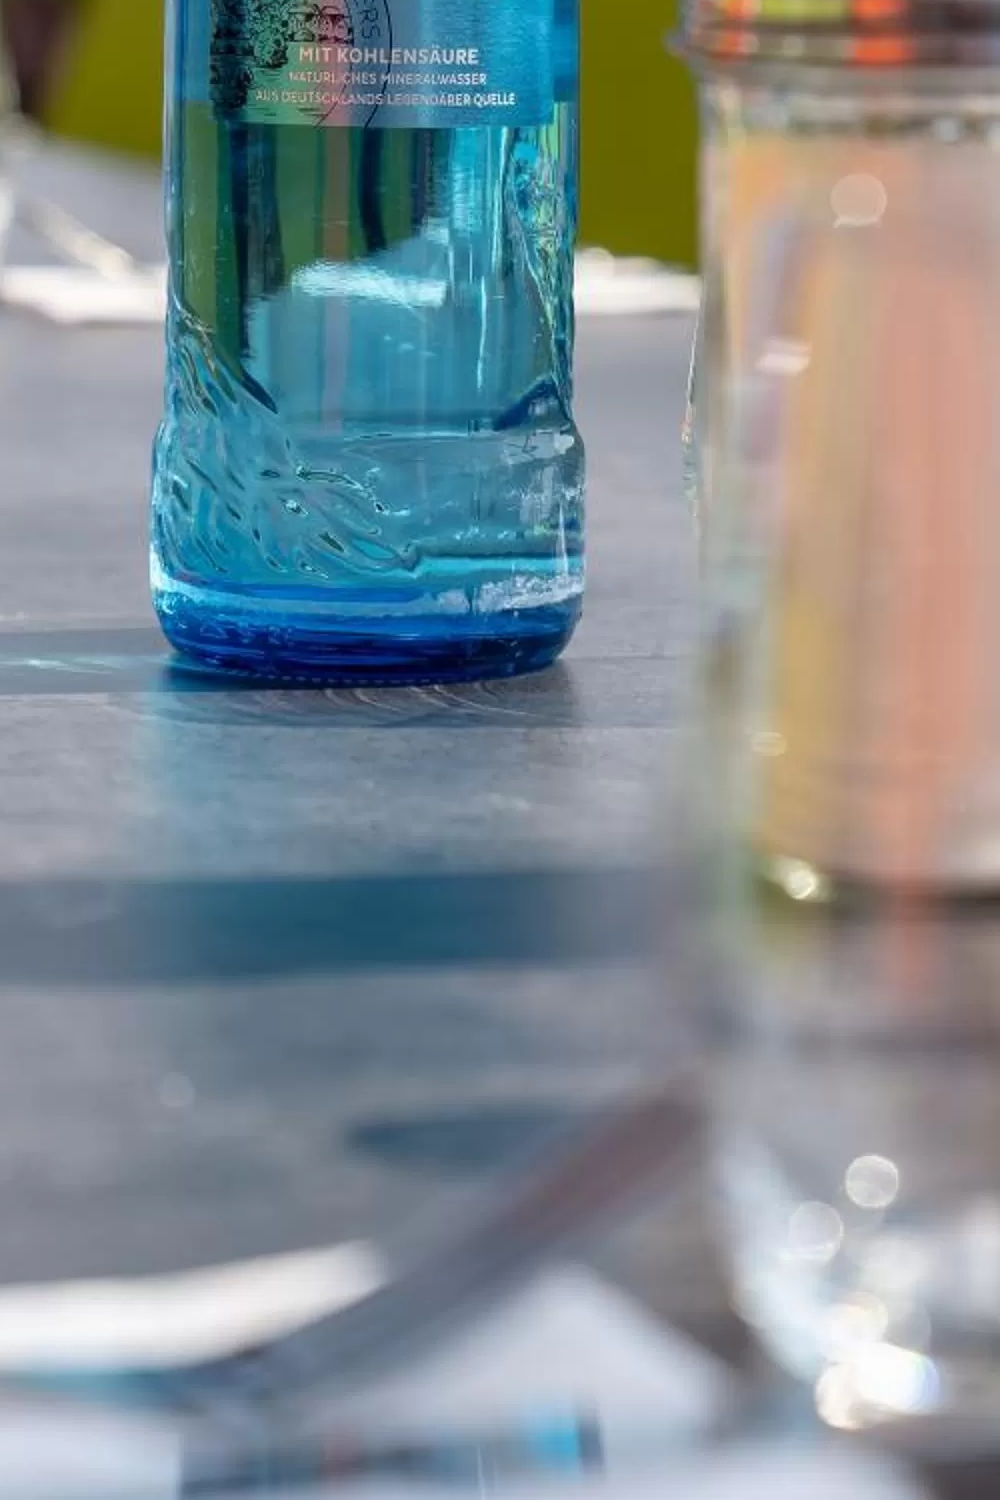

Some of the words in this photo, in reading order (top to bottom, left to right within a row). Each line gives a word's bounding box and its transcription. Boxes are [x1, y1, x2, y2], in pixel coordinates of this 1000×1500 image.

[300, 47, 333, 64] MIT
[337, 44, 480, 66] KOHLENSÄURE
[380, 72, 487, 86] MINERALWASSER
[473, 92, 517, 109] QUELLE
